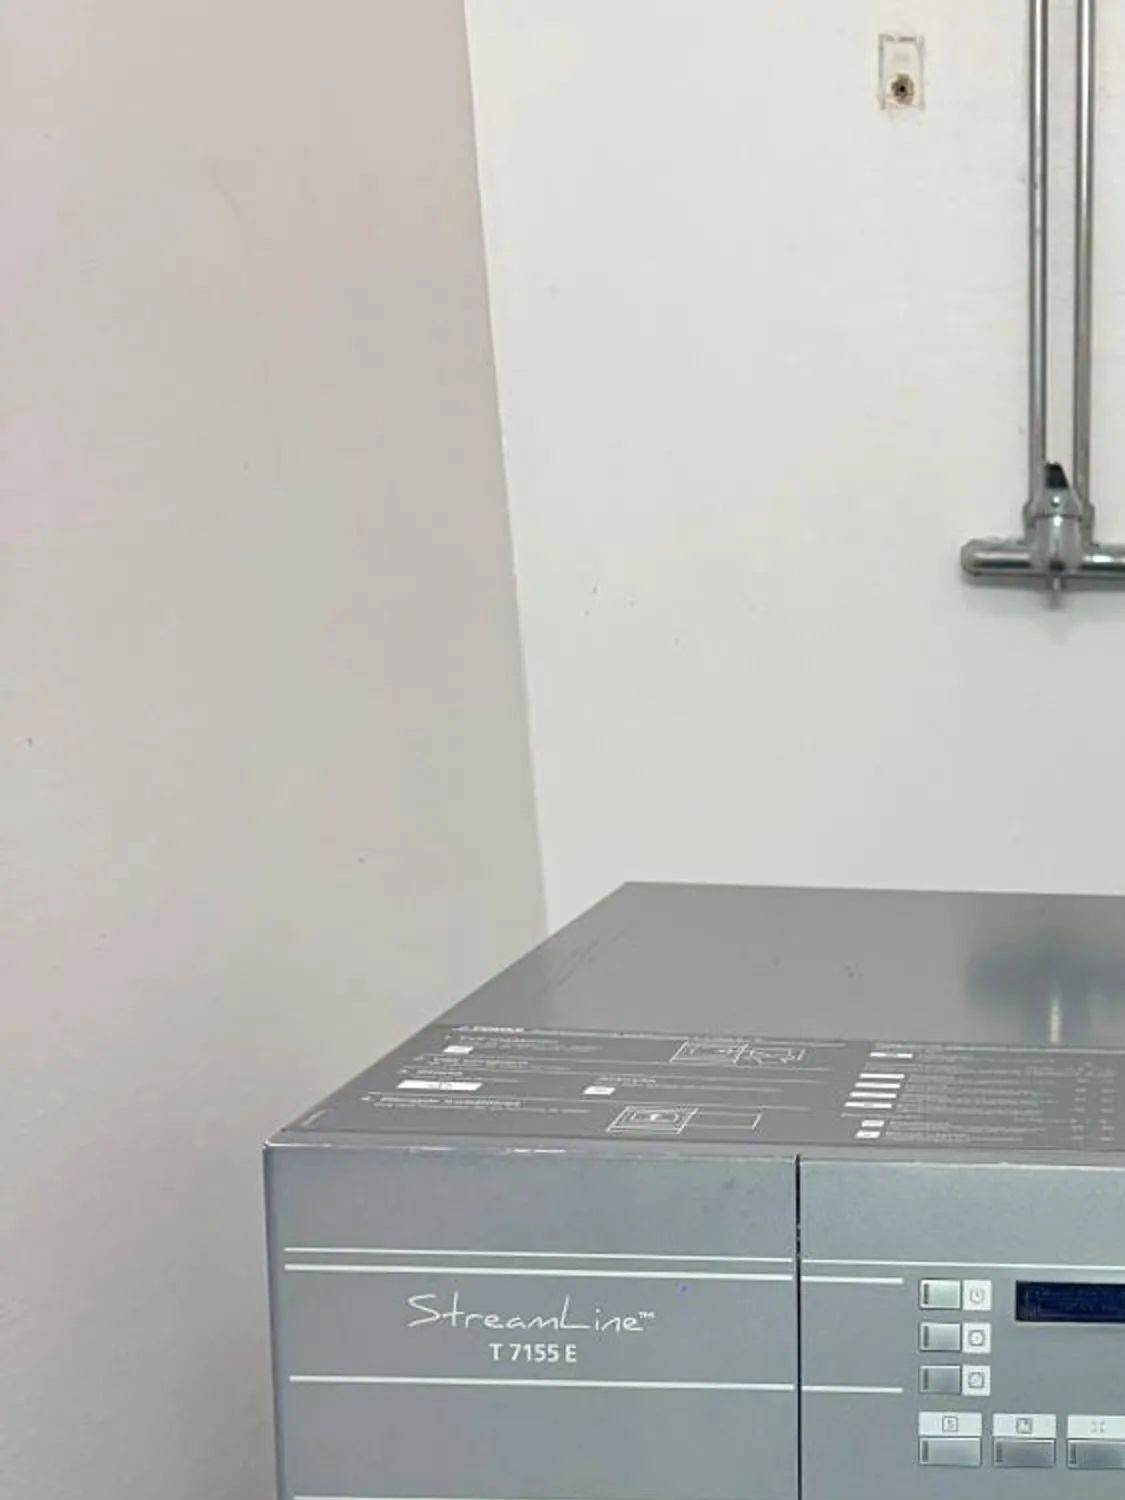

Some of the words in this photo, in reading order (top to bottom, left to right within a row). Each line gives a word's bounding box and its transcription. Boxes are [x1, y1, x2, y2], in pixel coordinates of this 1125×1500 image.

[489, 1342, 503, 1361] T
[509, 1343, 560, 1362] 7155
[564, 1343, 577, 1363] E
